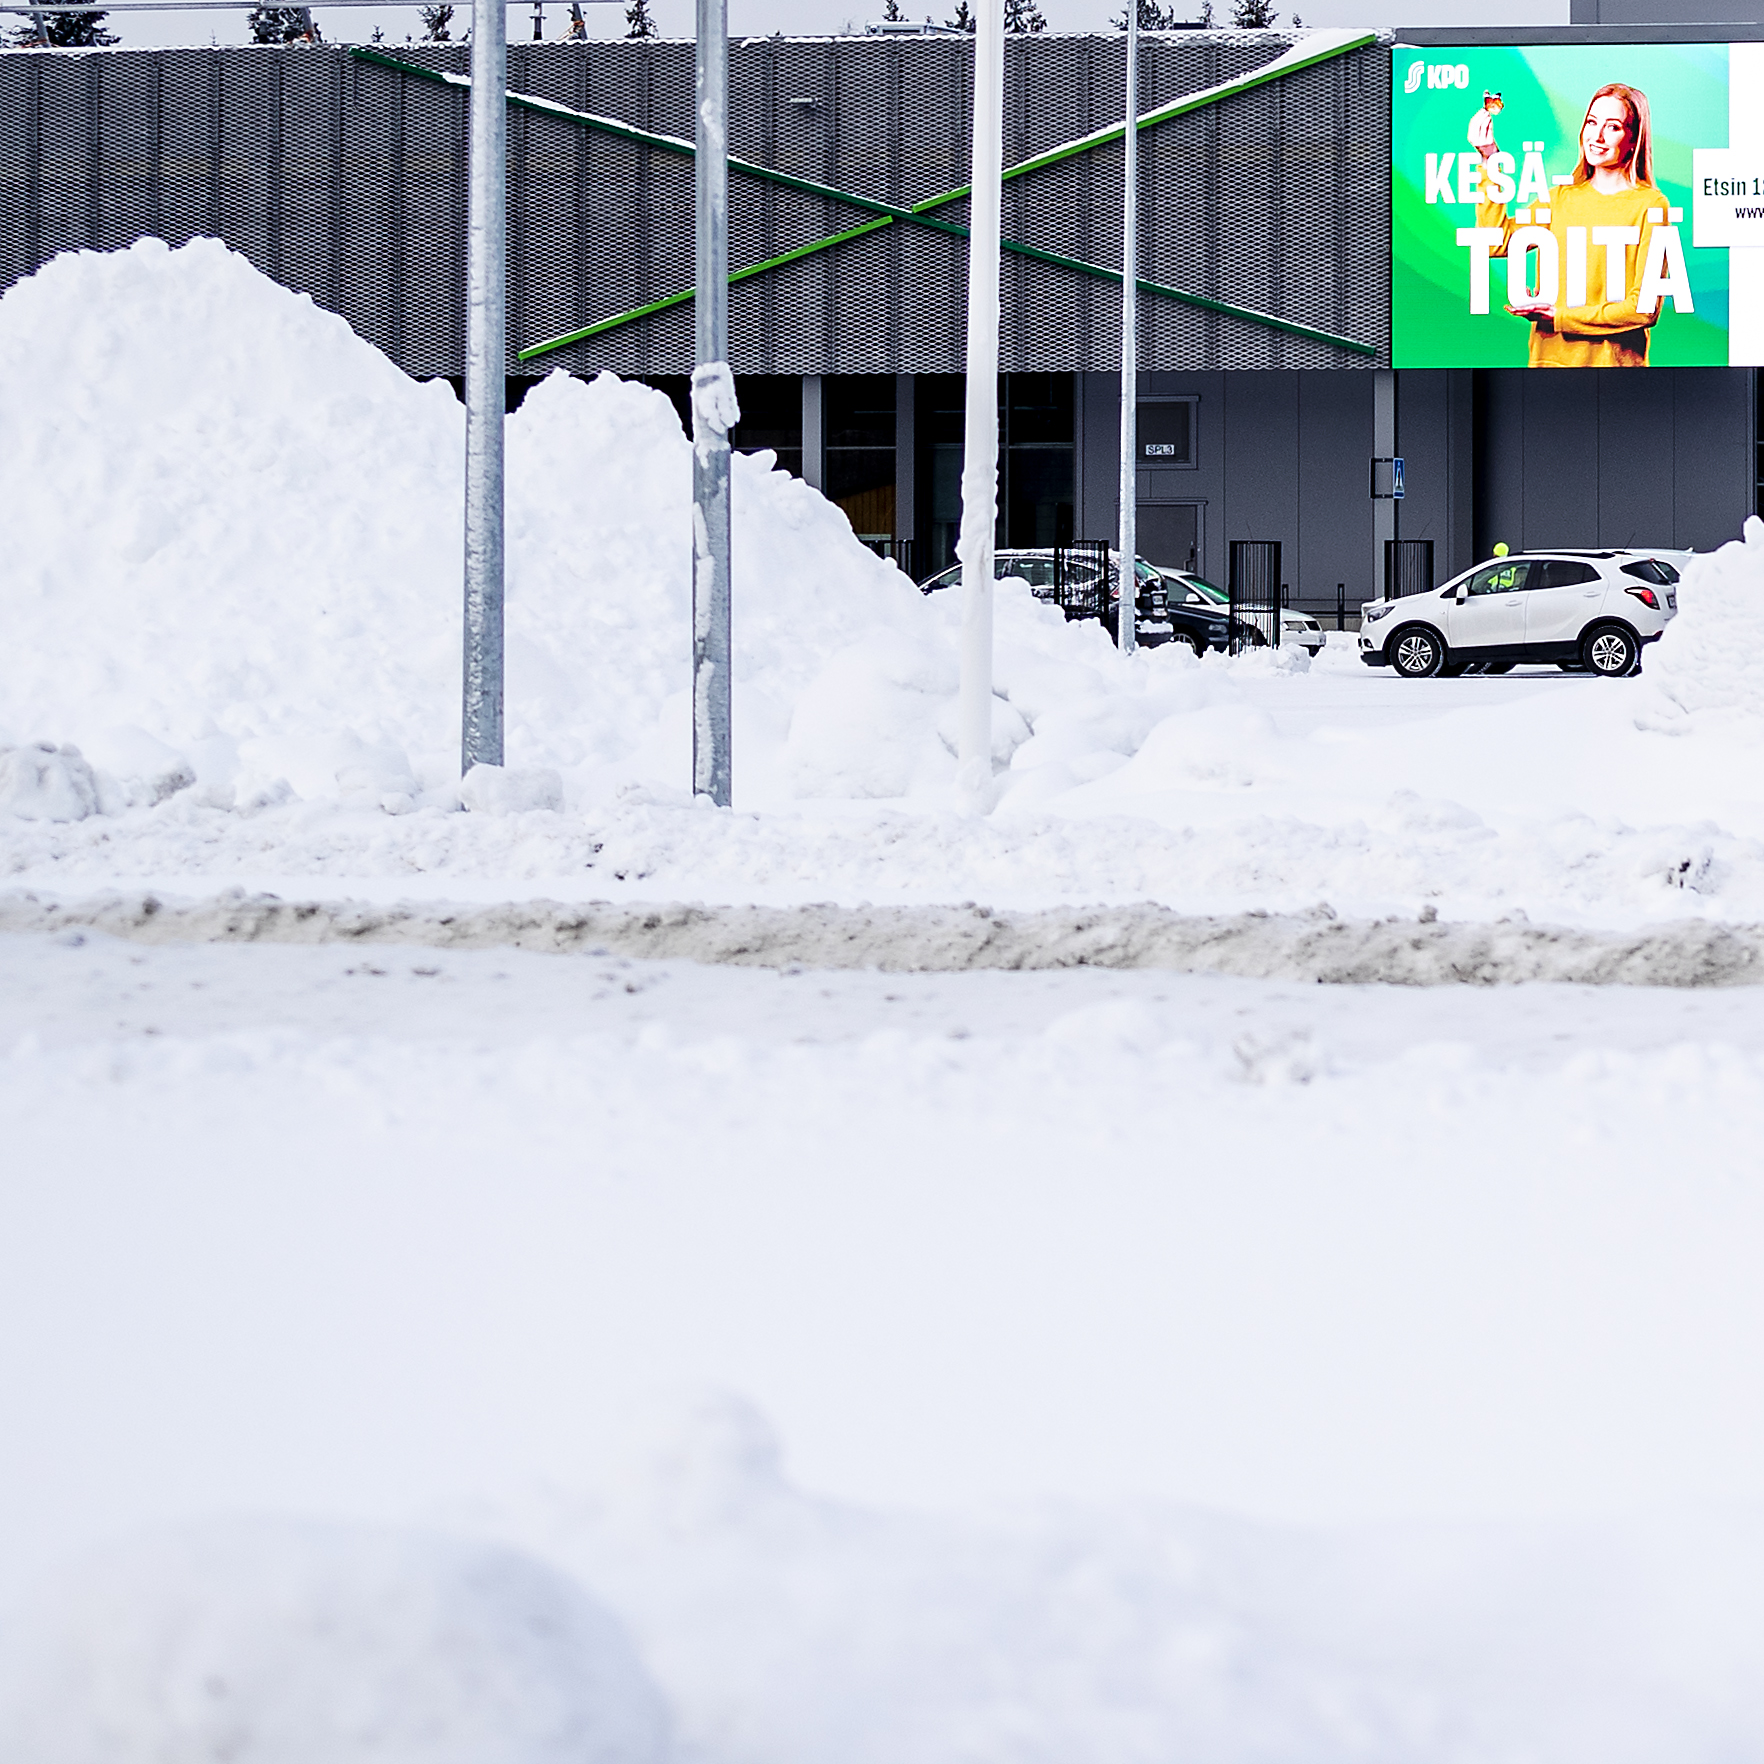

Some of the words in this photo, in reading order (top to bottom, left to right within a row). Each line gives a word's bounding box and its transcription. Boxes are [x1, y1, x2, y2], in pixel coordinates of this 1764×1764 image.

[1427, 64, 1470, 89] KPO
[1425, 141, 1574, 204] KESÄ-
[1703, 177, 1747, 196] Etsin
[1456, 207, 1695, 315] TÖITÄ
